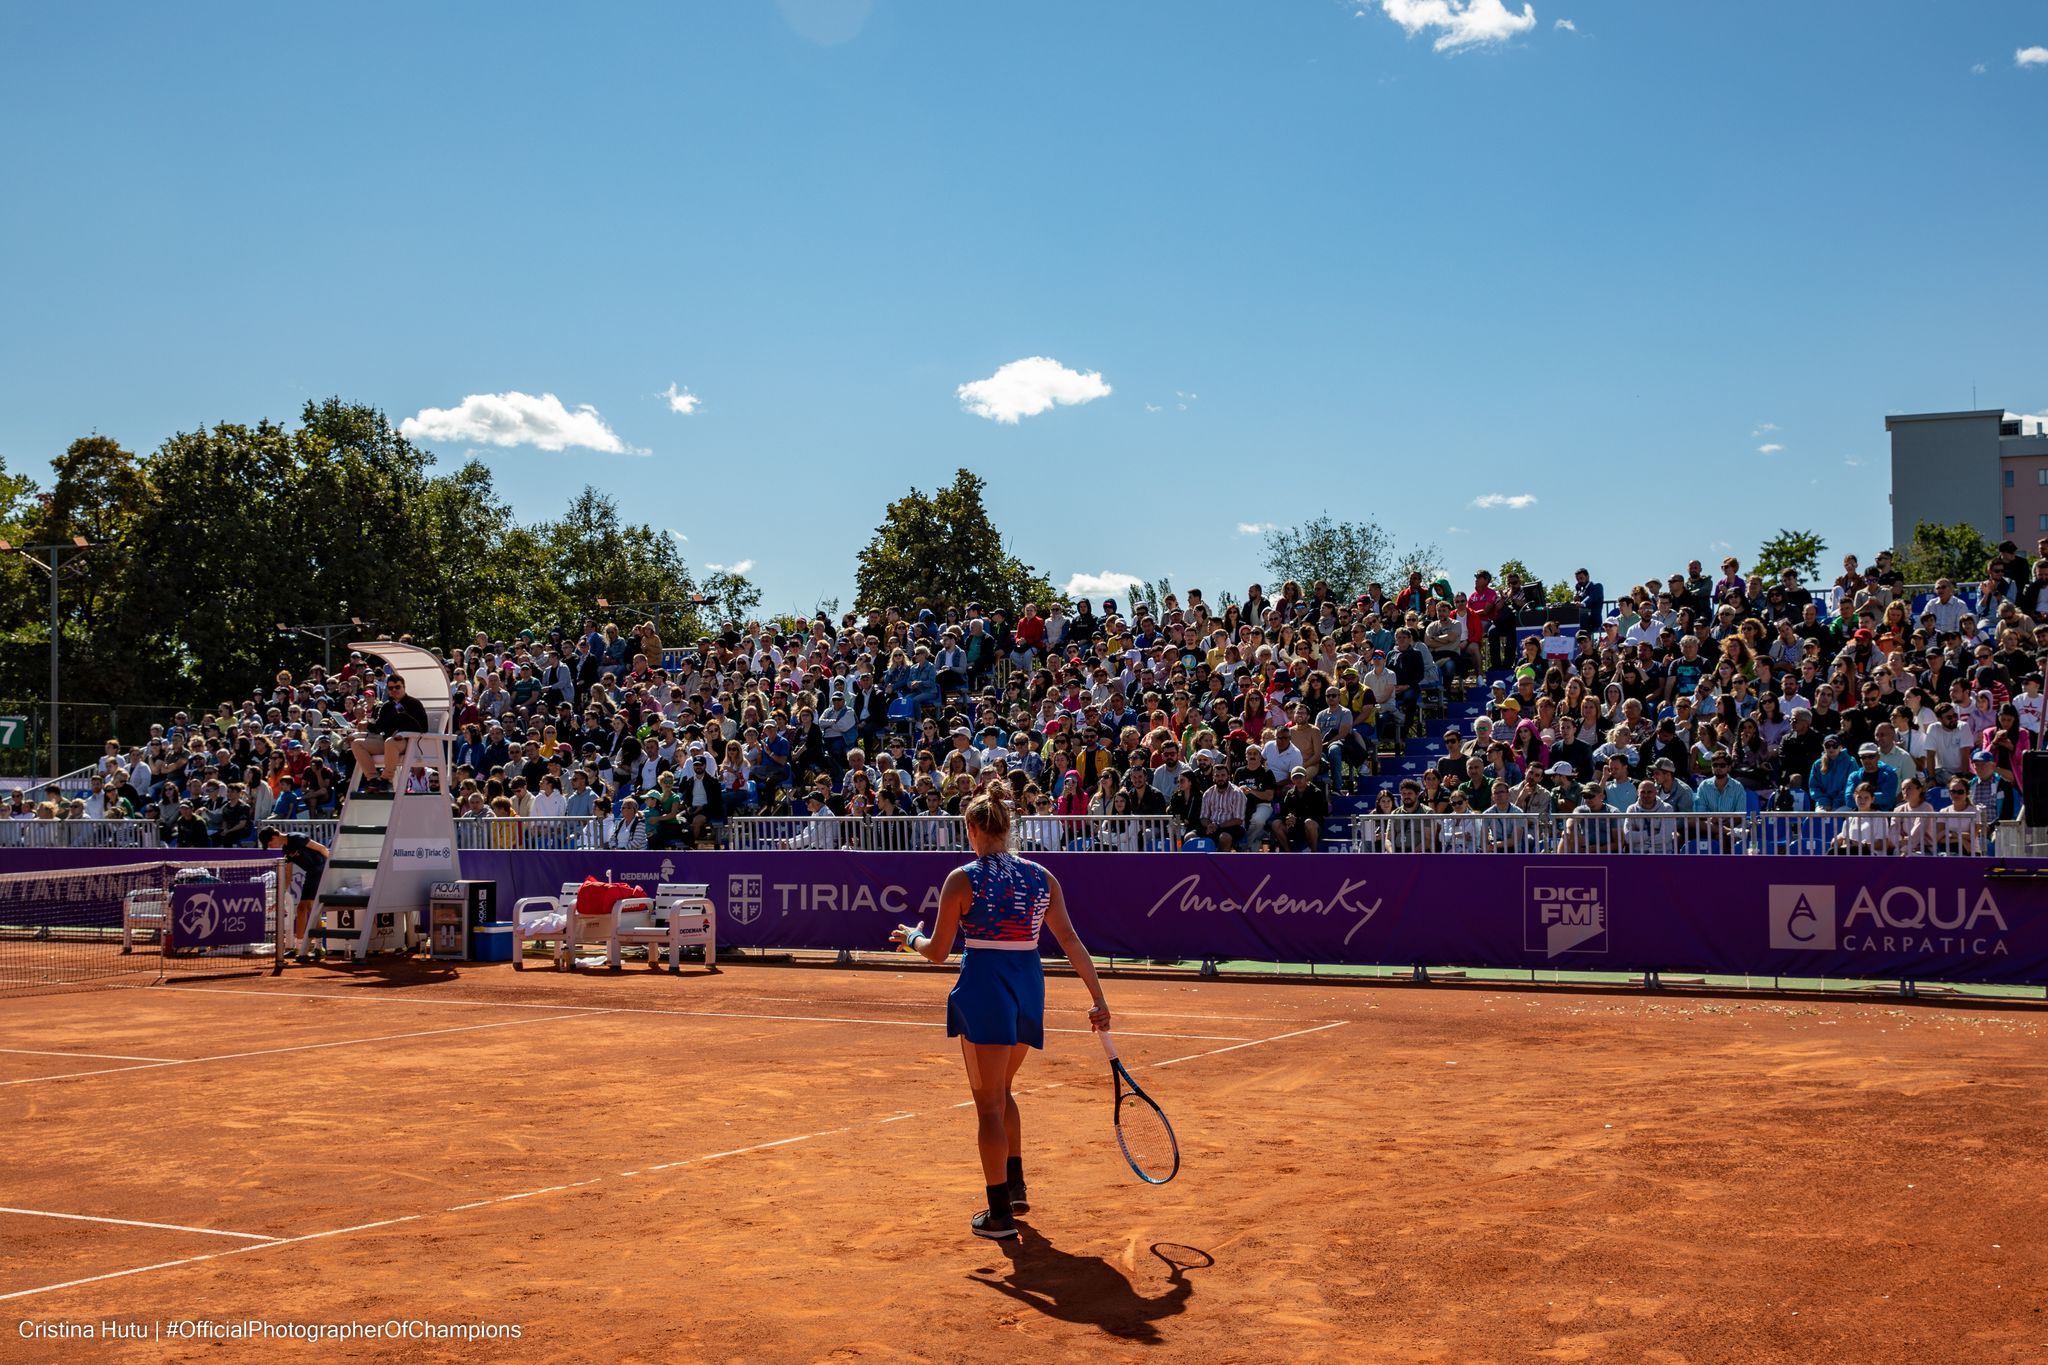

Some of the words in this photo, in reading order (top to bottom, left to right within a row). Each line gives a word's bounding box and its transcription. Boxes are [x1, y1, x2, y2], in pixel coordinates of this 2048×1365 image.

[0, 721, 17, 745] 7
[393, 849, 415, 857] Allianz
[620, 872, 660, 881] DEDEMAN
[435, 883, 460, 893] AQUA
[1534, 887, 1597, 901] DIGI
[222, 898, 262, 913] WTA
[1843, 885, 2008, 931] AQUA
[1541, 903, 1590, 924] FM
[222, 916, 246, 932] 125
[1843, 935, 2008, 955] CARPATICA
